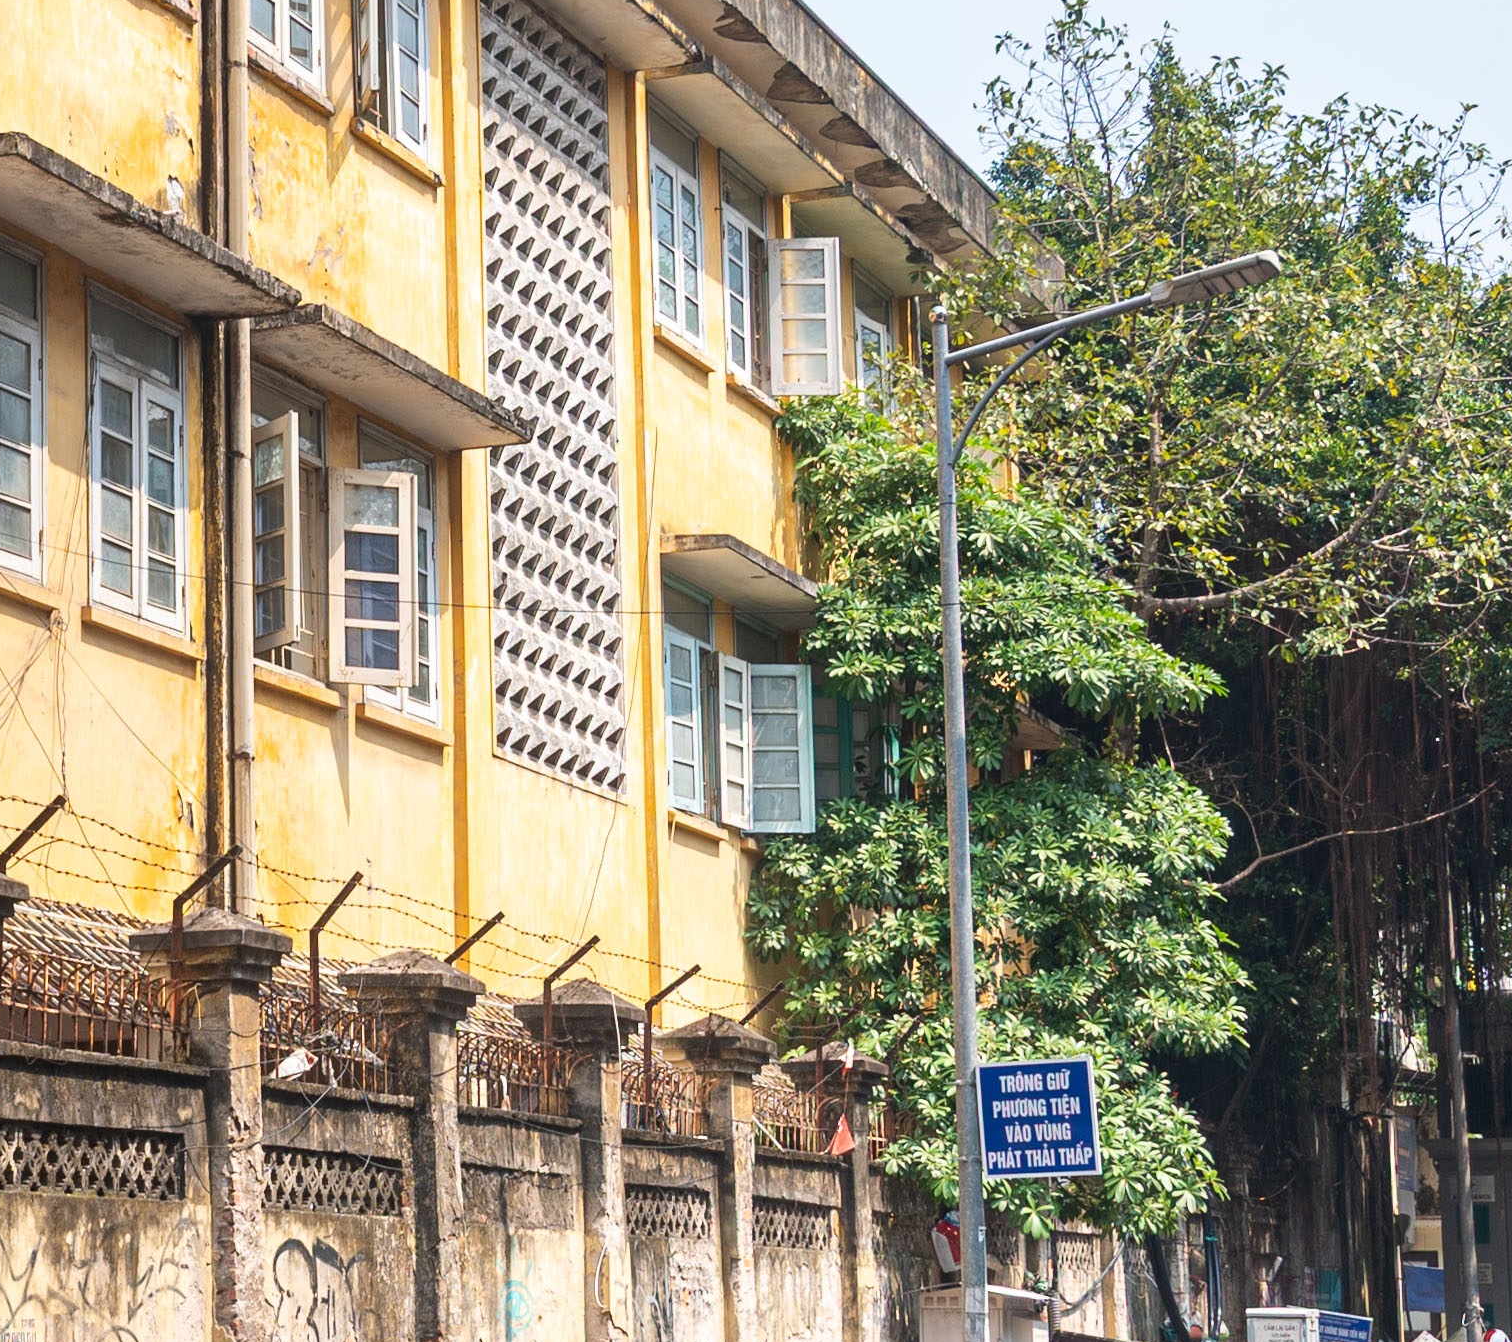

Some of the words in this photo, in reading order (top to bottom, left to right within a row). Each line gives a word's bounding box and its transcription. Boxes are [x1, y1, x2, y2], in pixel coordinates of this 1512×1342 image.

[998, 1071, 1043, 1093] TRÔNG
[1046, 1069, 1071, 1091] GIỮ
[992, 1097, 1046, 1119] PHƯƠNG
[1049, 1093, 1081, 1120] TIỆN
[1005, 1121, 1032, 1144] VÀO
[1034, 1120, 1072, 1141] VÙNG
[988, 1146, 1023, 1170] PHÁT
[1025, 1143, 1056, 1168] THẢI
[1058, 1141, 1093, 1166] THẤP
